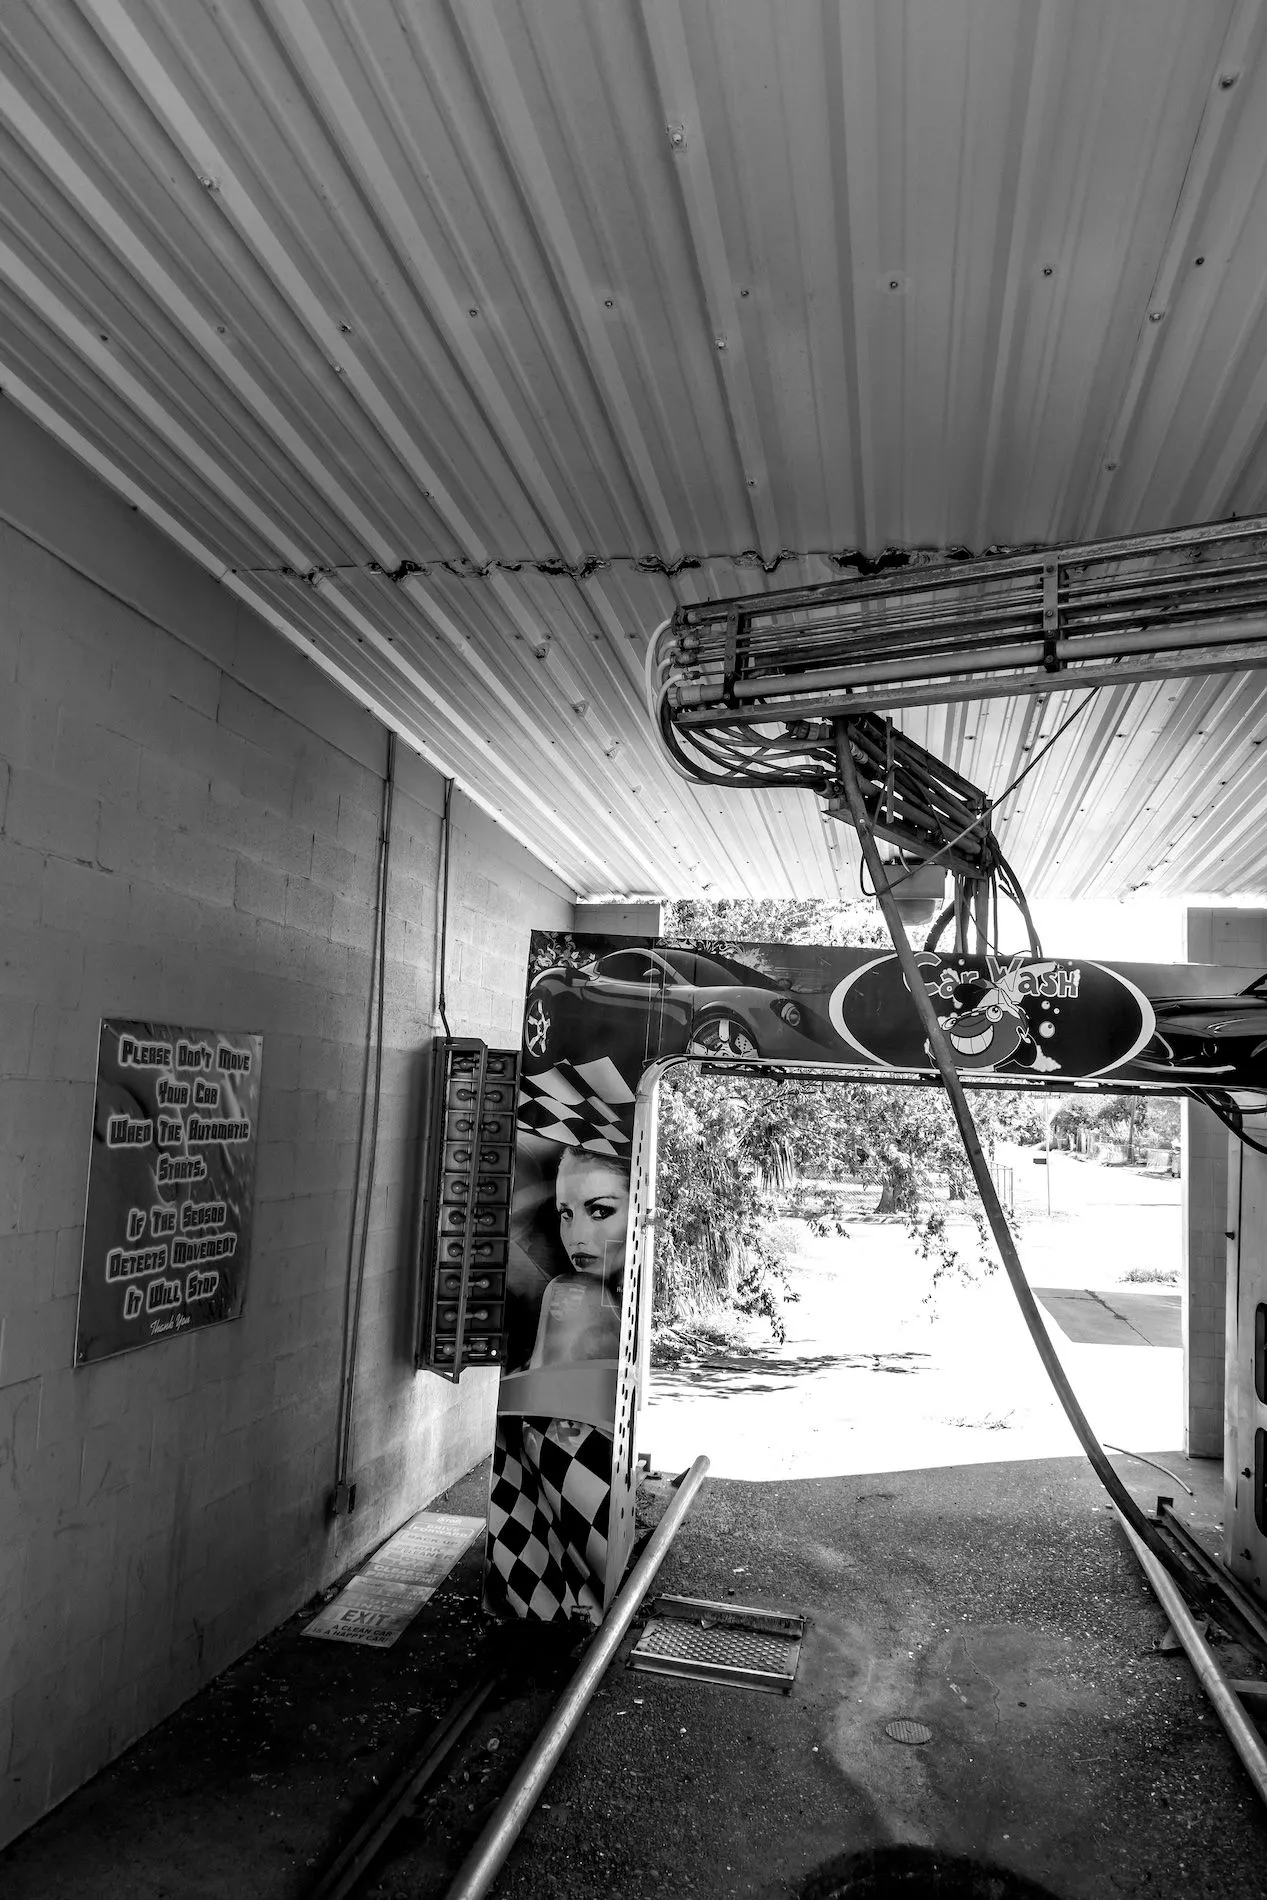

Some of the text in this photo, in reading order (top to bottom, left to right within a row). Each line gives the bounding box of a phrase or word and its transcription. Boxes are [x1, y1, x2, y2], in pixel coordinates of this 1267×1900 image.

[119, 1035, 173, 1069] PLEASE
[217, 1045, 251, 1073] MOVE
[156, 1077, 219, 1107] YOUR CAR
[107, 1115, 250, 1148] WHEN THE AUTOMATIC
[127, 1200, 226, 1241] IF THE SENSOR
[106, 1232, 237, 1283] DETECTS MOVEMENT
[124, 1271, 219, 1319] IT WILL STOP
[150, 1317, 174, 1336] Thank
[340, 1609, 392, 1625] EXIT
[341, 1625, 372, 1634] CLEAN
[333, 1630, 364, 1639] HAPPY
